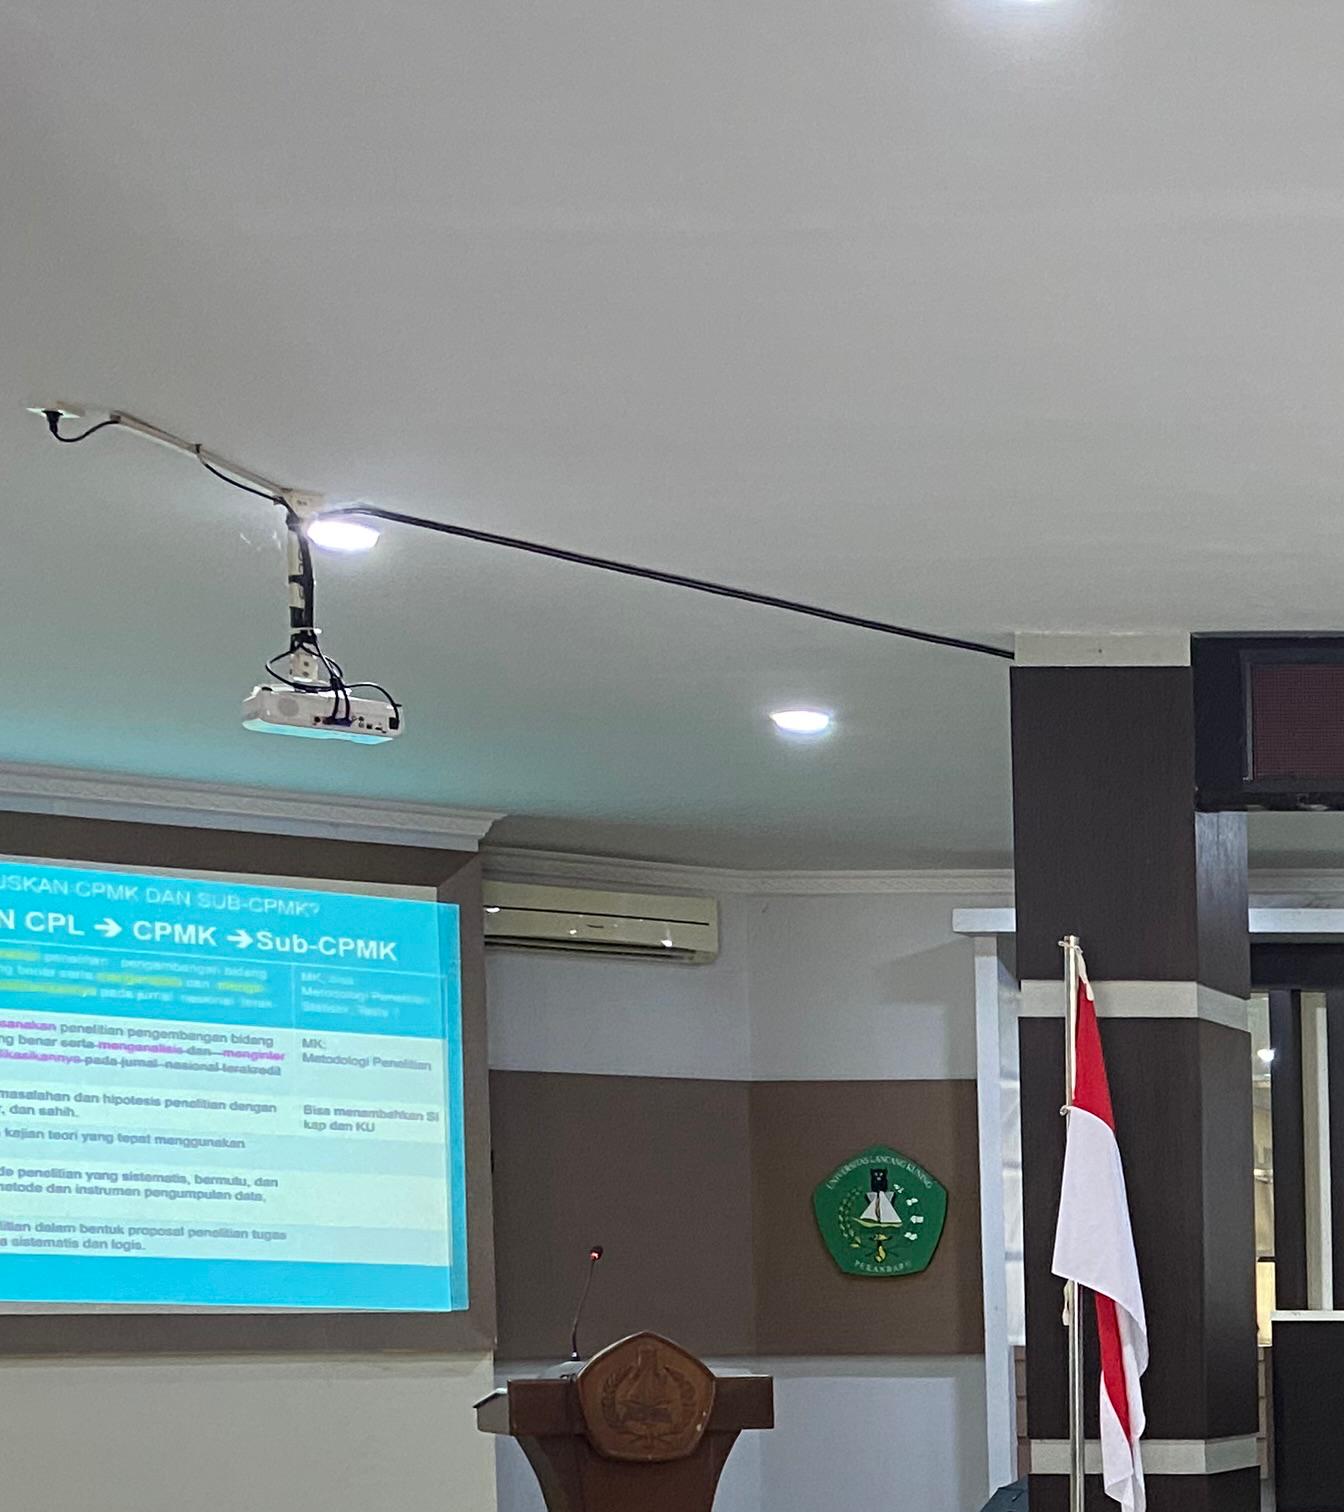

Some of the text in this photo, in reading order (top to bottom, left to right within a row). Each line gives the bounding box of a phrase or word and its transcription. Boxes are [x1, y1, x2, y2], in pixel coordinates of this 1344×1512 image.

[76, 881, 139, 902] CPMK
[145, 888, 191, 908] DAN
[197, 892, 320, 917] SUB-CPMK?
[25, 911, 85, 936] CPL
[133, 920, 217, 946] CPMK
[256, 931, 397, 961] Sub-CPMK
[231, 1033, 273, 1049] bidang
[9, 1104, 35, 1115] dan
[74, 1092, 100, 1104] dan
[229, 1101, 277, 1114] dengan
[81, 1132, 114, 1144] yang
[85, 1171, 118, 1184] yang
[254, 1176, 278, 1188] dan
[46, 1183, 72, 1195] dan
[35, 1222, 76, 1234] dalam
[79, 1223, 125, 1236] bentuk
[128, 1226, 185, 1238] proposal
[252, 1229, 287, 1241] tugas
[82, 1238, 108, 1250] dan
